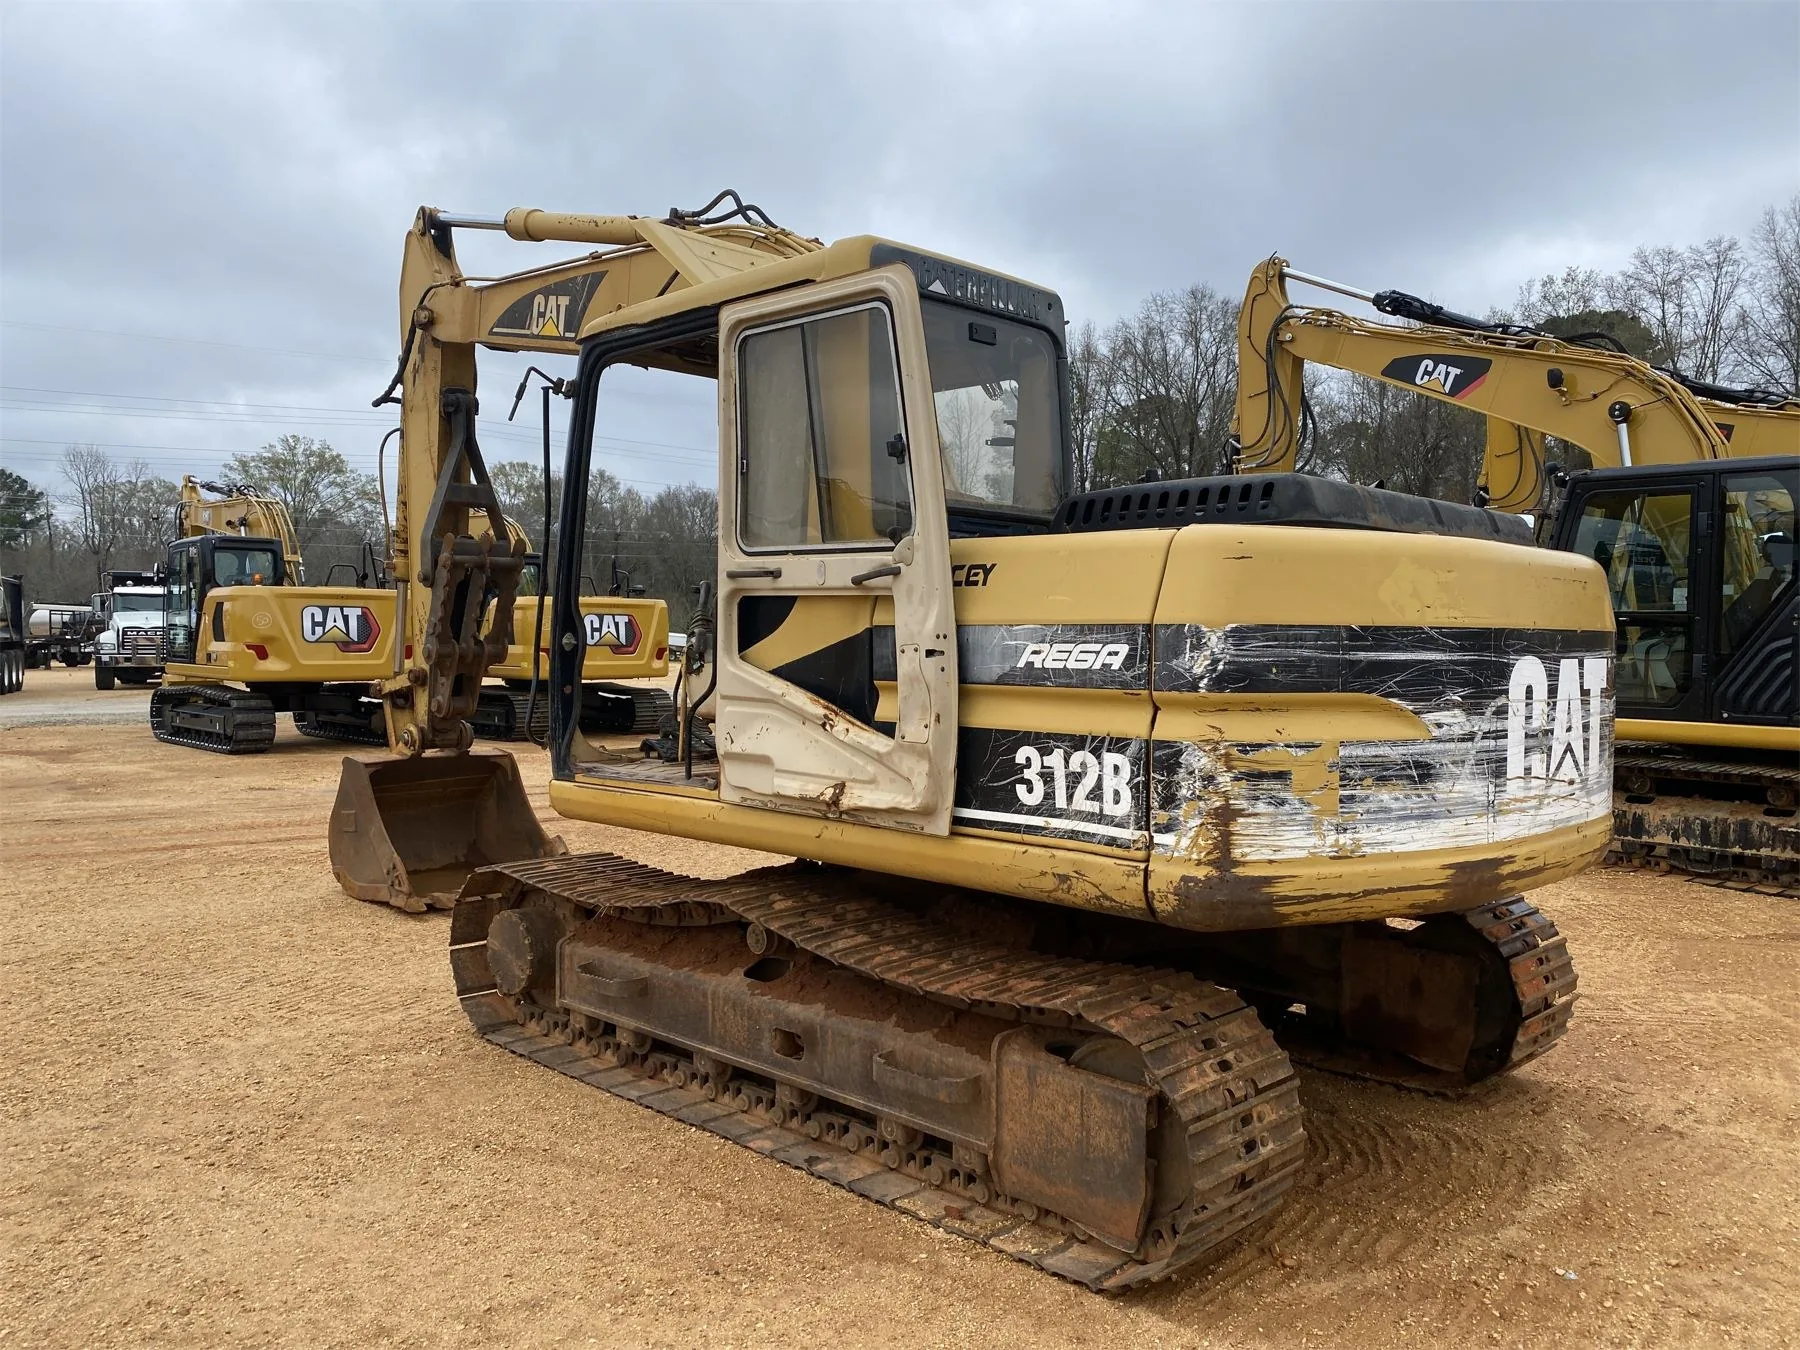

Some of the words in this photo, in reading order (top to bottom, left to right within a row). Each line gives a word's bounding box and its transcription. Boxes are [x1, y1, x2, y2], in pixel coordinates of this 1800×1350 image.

[918, 257, 1040, 320] CATERPILLAR
[532, 294, 570, 336] CAT
[1415, 359, 1462, 394] CAT
[952, 563, 997, 587] CEY
[302, 606, 361, 642] CAT
[584, 614, 628, 645] CAT
[1016, 643, 1130, 670] REGA
[1507, 656, 1607, 791] CAT
[1015, 745, 1132, 817] 312B
